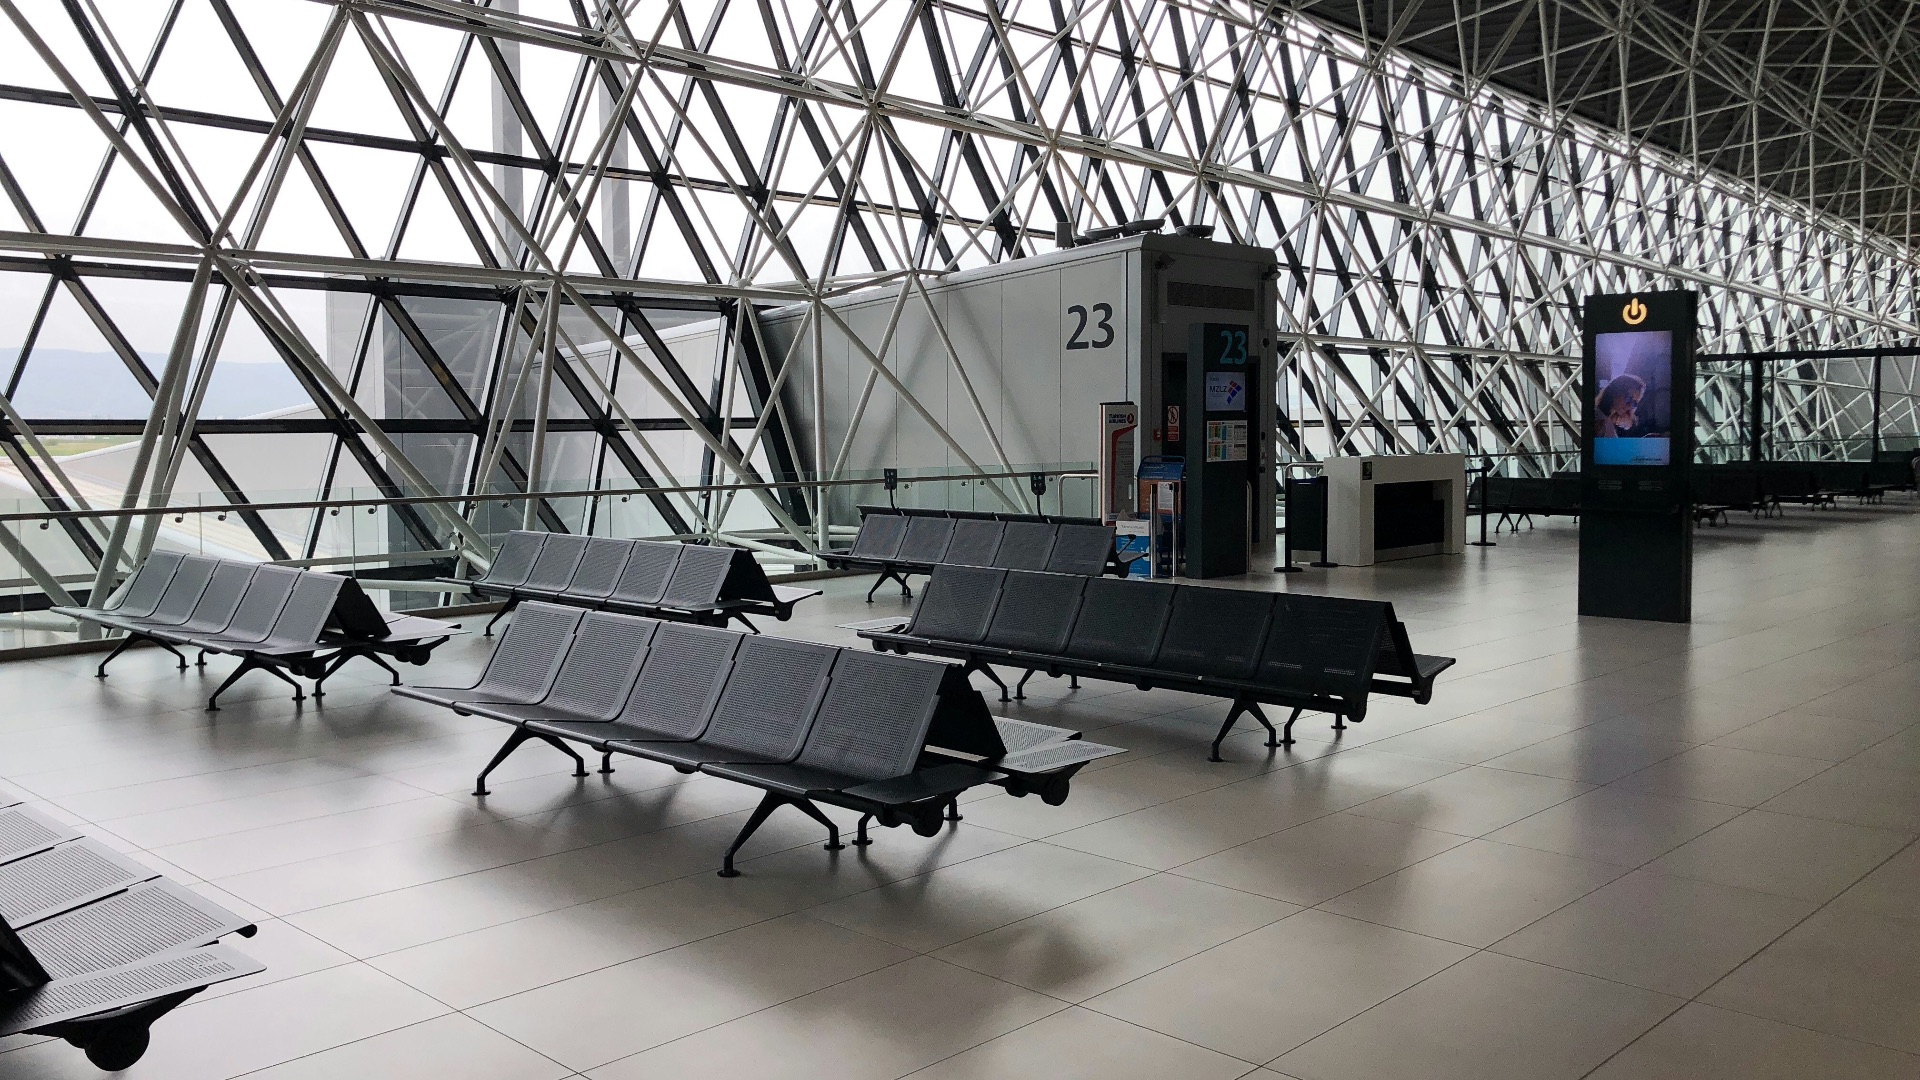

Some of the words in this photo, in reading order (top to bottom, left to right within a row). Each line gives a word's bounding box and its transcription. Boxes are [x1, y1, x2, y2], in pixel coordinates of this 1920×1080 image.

[1066, 303, 1114, 350] 23
[1220, 330, 1247, 364] 23
[1209, 385, 1227, 393] MZLZ
